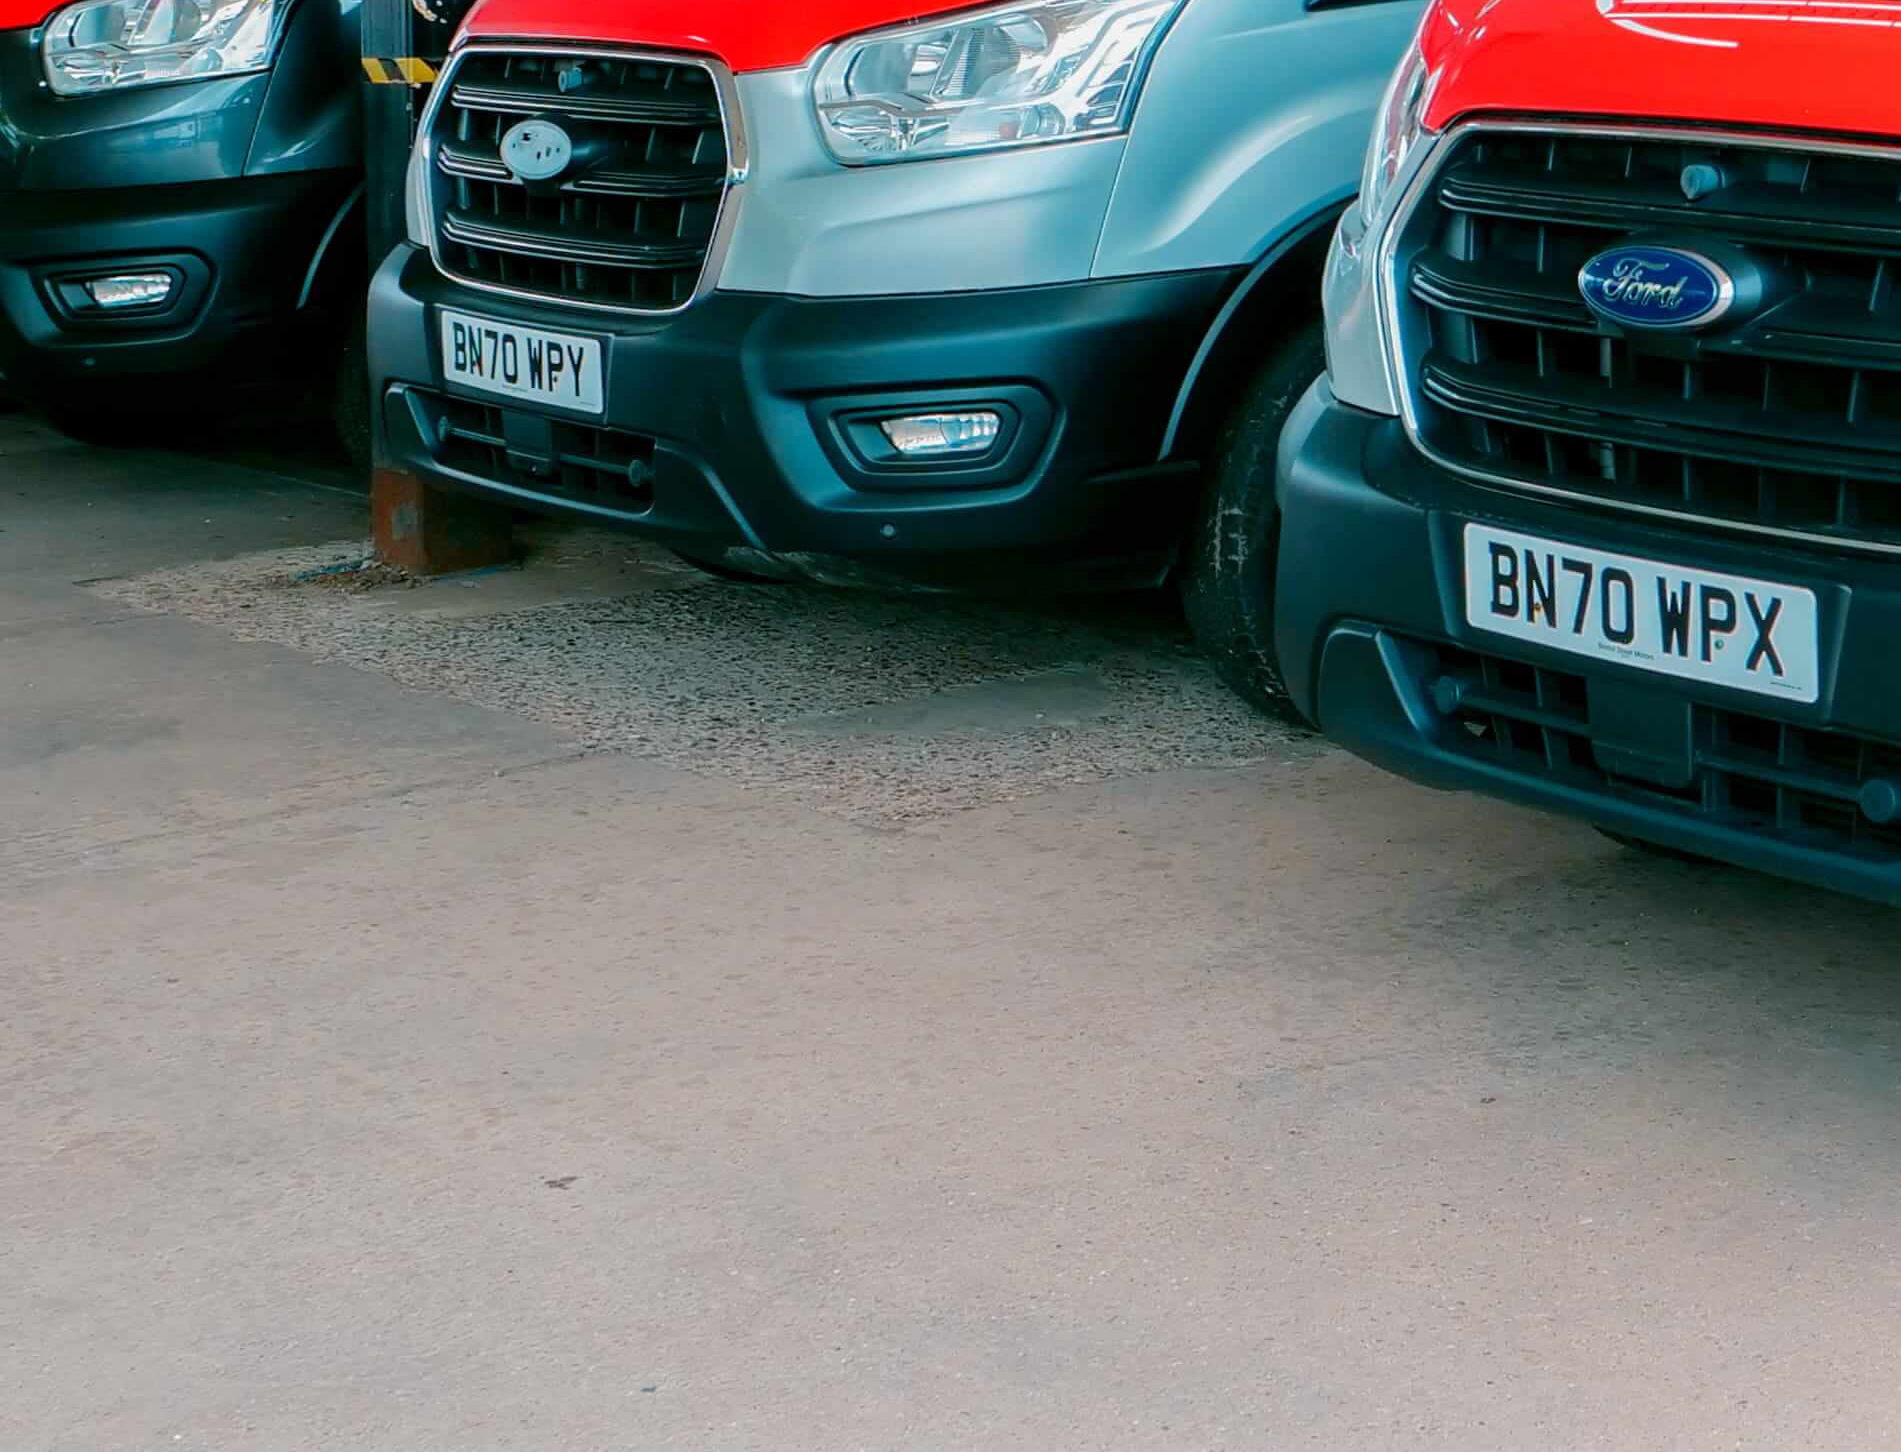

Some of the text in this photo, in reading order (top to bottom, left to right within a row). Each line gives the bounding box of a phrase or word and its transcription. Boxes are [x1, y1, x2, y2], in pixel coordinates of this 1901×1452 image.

[1601, 257, 1690, 309] Ford
[452, 321, 584, 397] BN70 WPY
[1487, 540, 1785, 678] BN70 WPX
